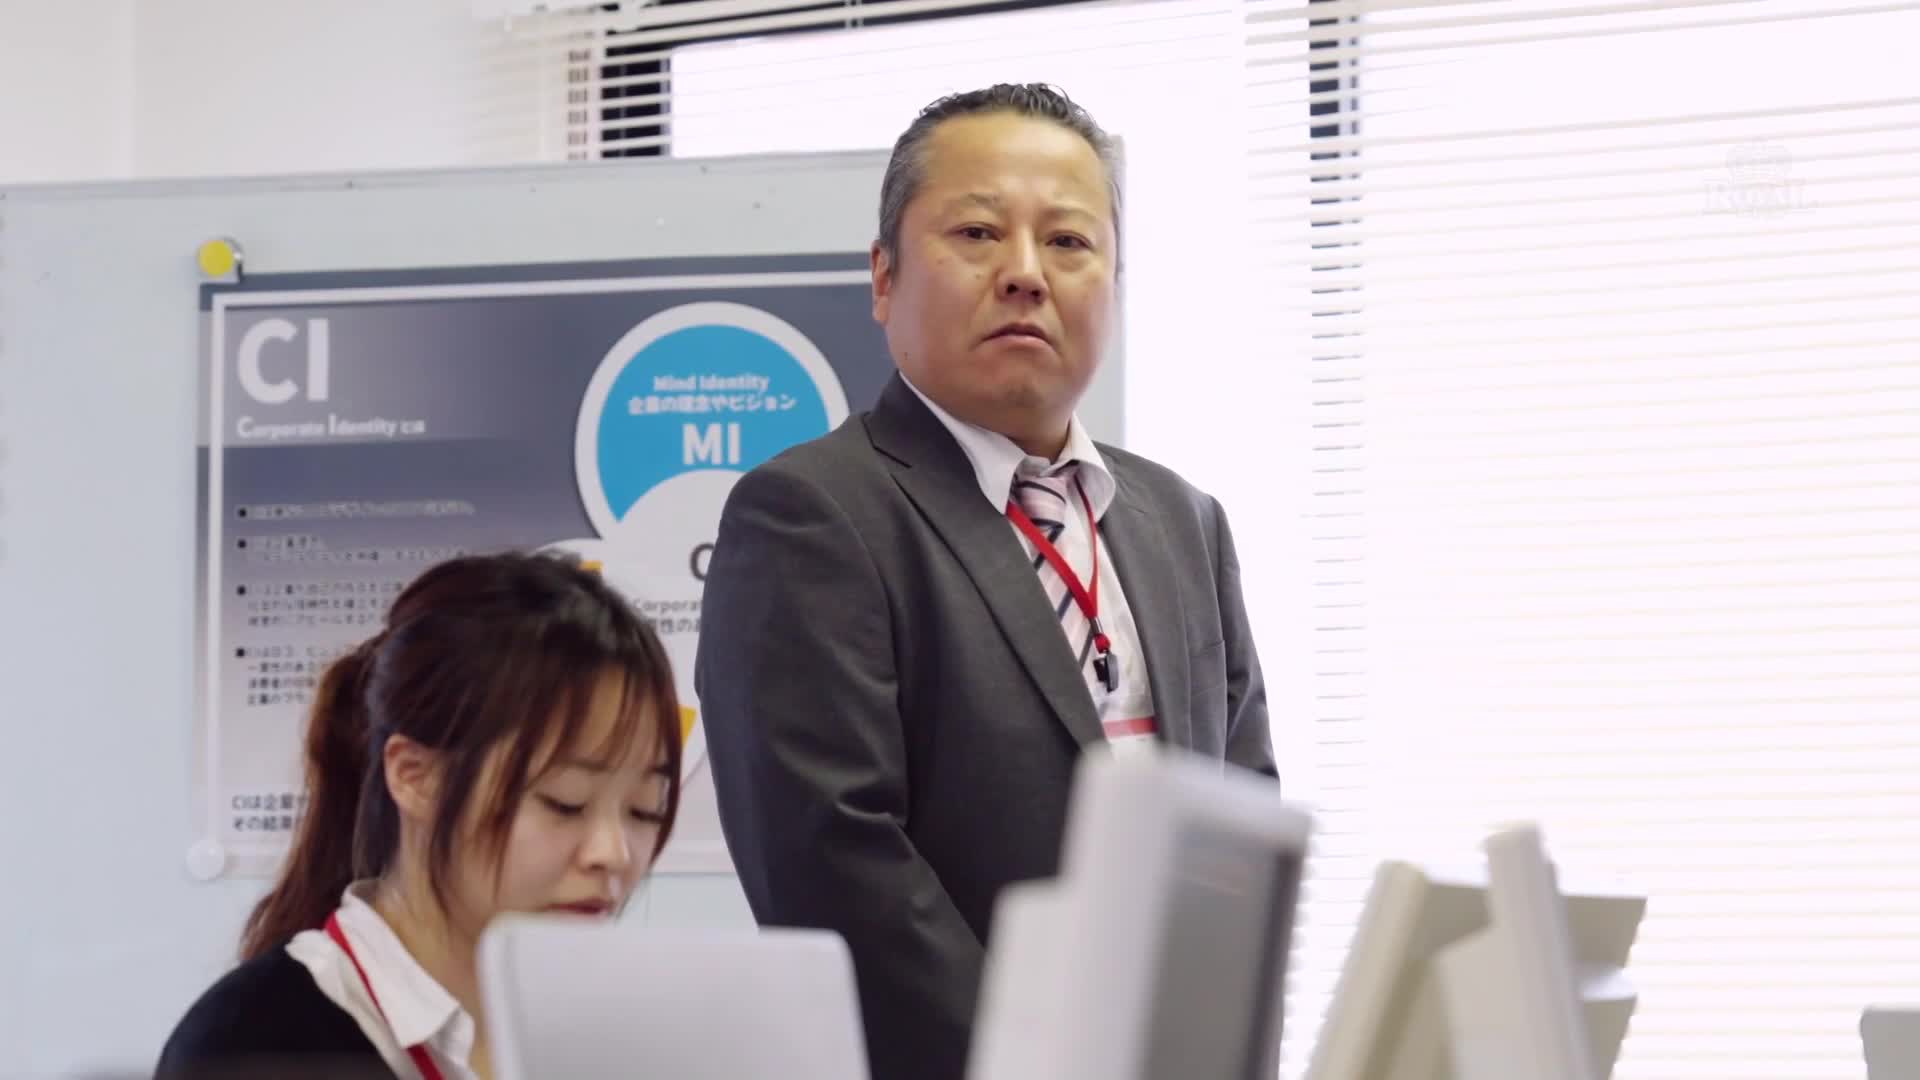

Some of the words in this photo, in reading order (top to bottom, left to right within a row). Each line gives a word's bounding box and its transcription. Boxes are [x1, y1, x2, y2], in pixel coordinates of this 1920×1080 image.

[237, 318, 328, 404] CI
[653, 374, 697, 392] Mind
[700, 373, 770, 394] Identity
[328, 412, 398, 439] Identity
[682, 422, 741, 465] MI
